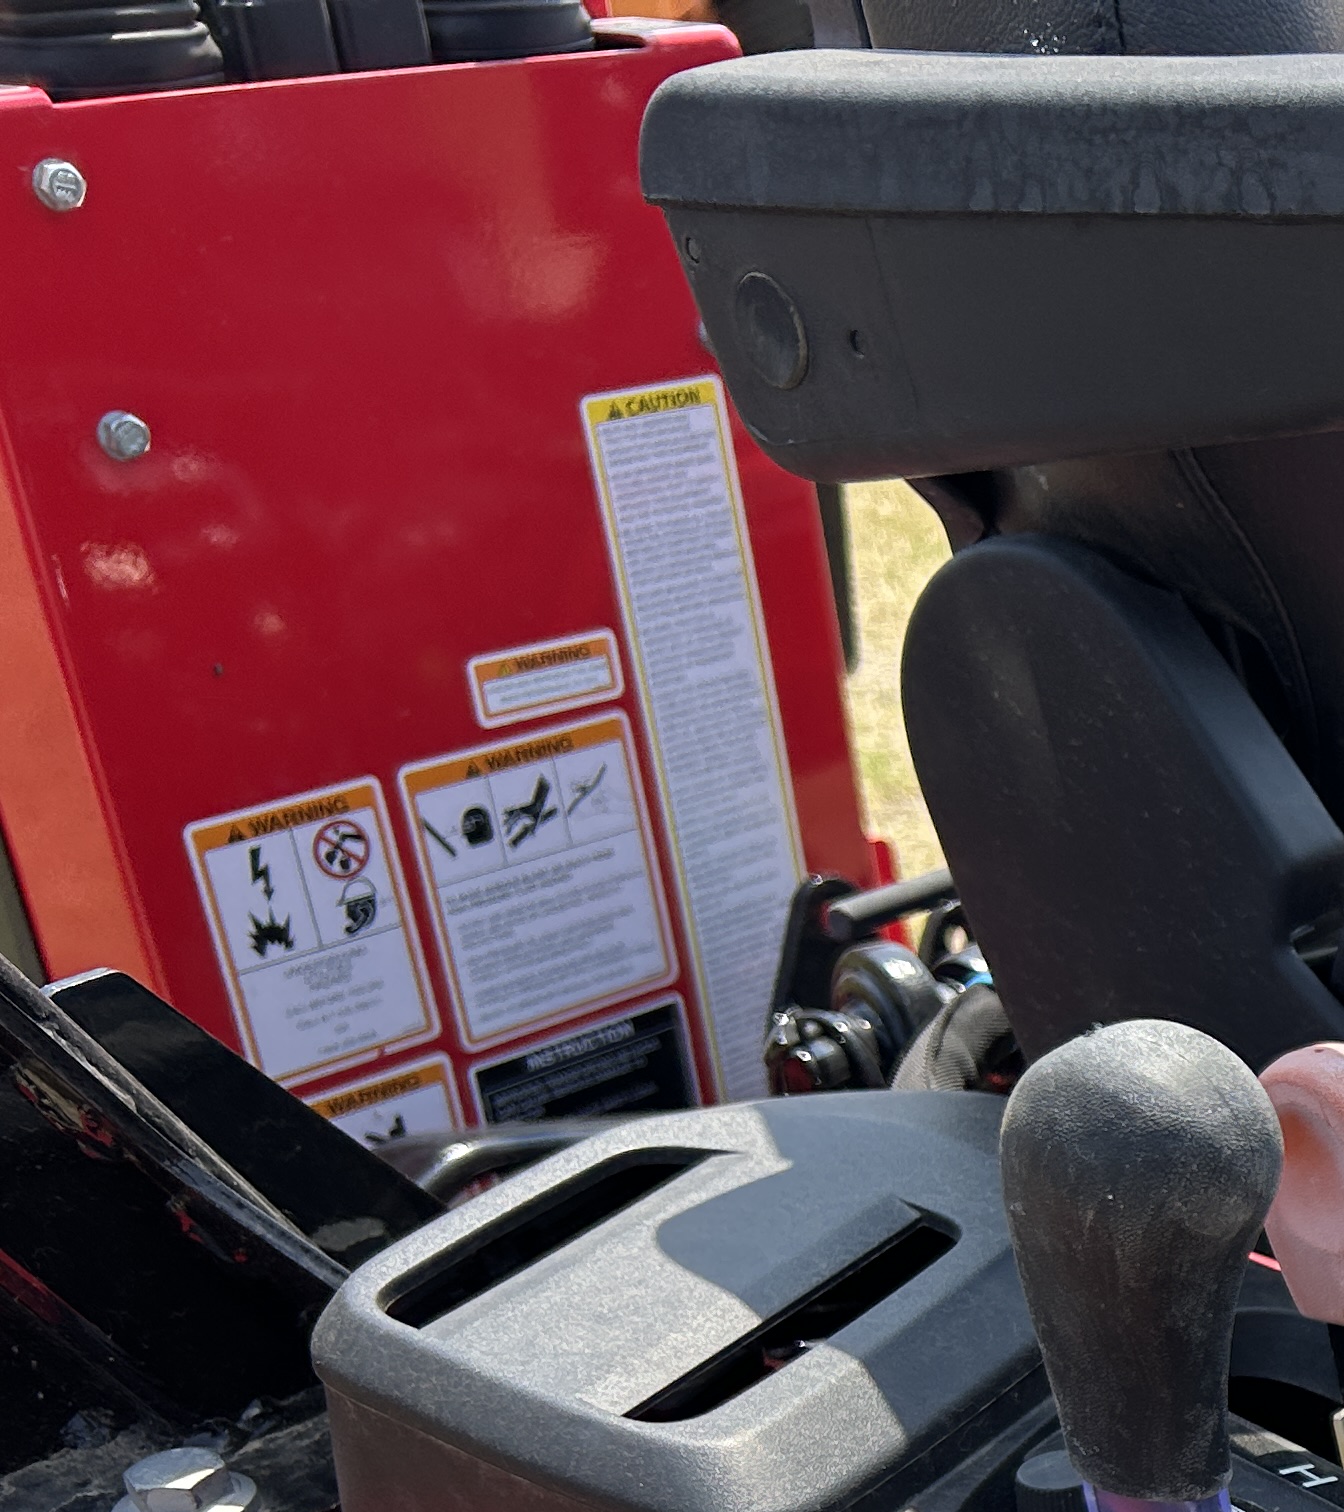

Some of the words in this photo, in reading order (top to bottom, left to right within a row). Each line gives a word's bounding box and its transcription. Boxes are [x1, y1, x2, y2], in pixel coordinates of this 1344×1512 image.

[624, 386, 701, 418] CAUTION
[516, 647, 591, 671] WARNING
[485, 734, 574, 771] WARNING
[248, 795, 351, 837] WARNING
[526, 1019, 636, 1072] INSTRUCTION
[326, 1076, 421, 1115] WARNING
[1278, 1463, 1339, 1489] H
